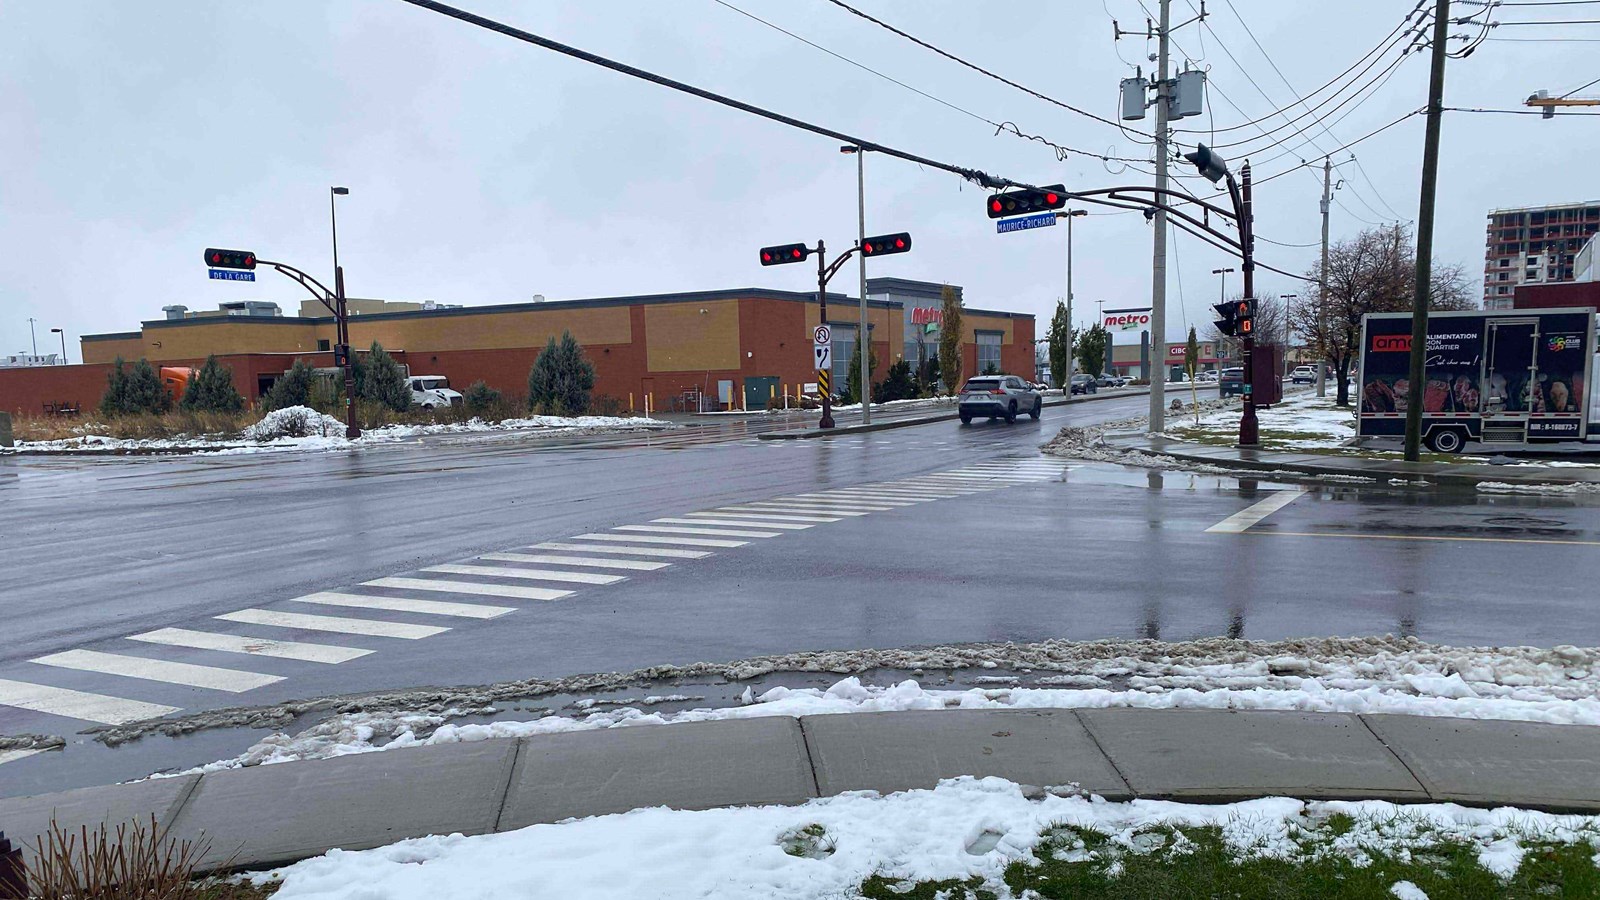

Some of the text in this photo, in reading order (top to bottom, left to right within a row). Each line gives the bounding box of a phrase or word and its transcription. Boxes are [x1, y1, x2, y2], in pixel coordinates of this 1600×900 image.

[997, 216, 1055, 232] MAURICE-RICHARD
[235, 273, 252, 281] GARE
[1104, 314, 1149, 326] metro
[1243, 320, 1251, 331] 0
